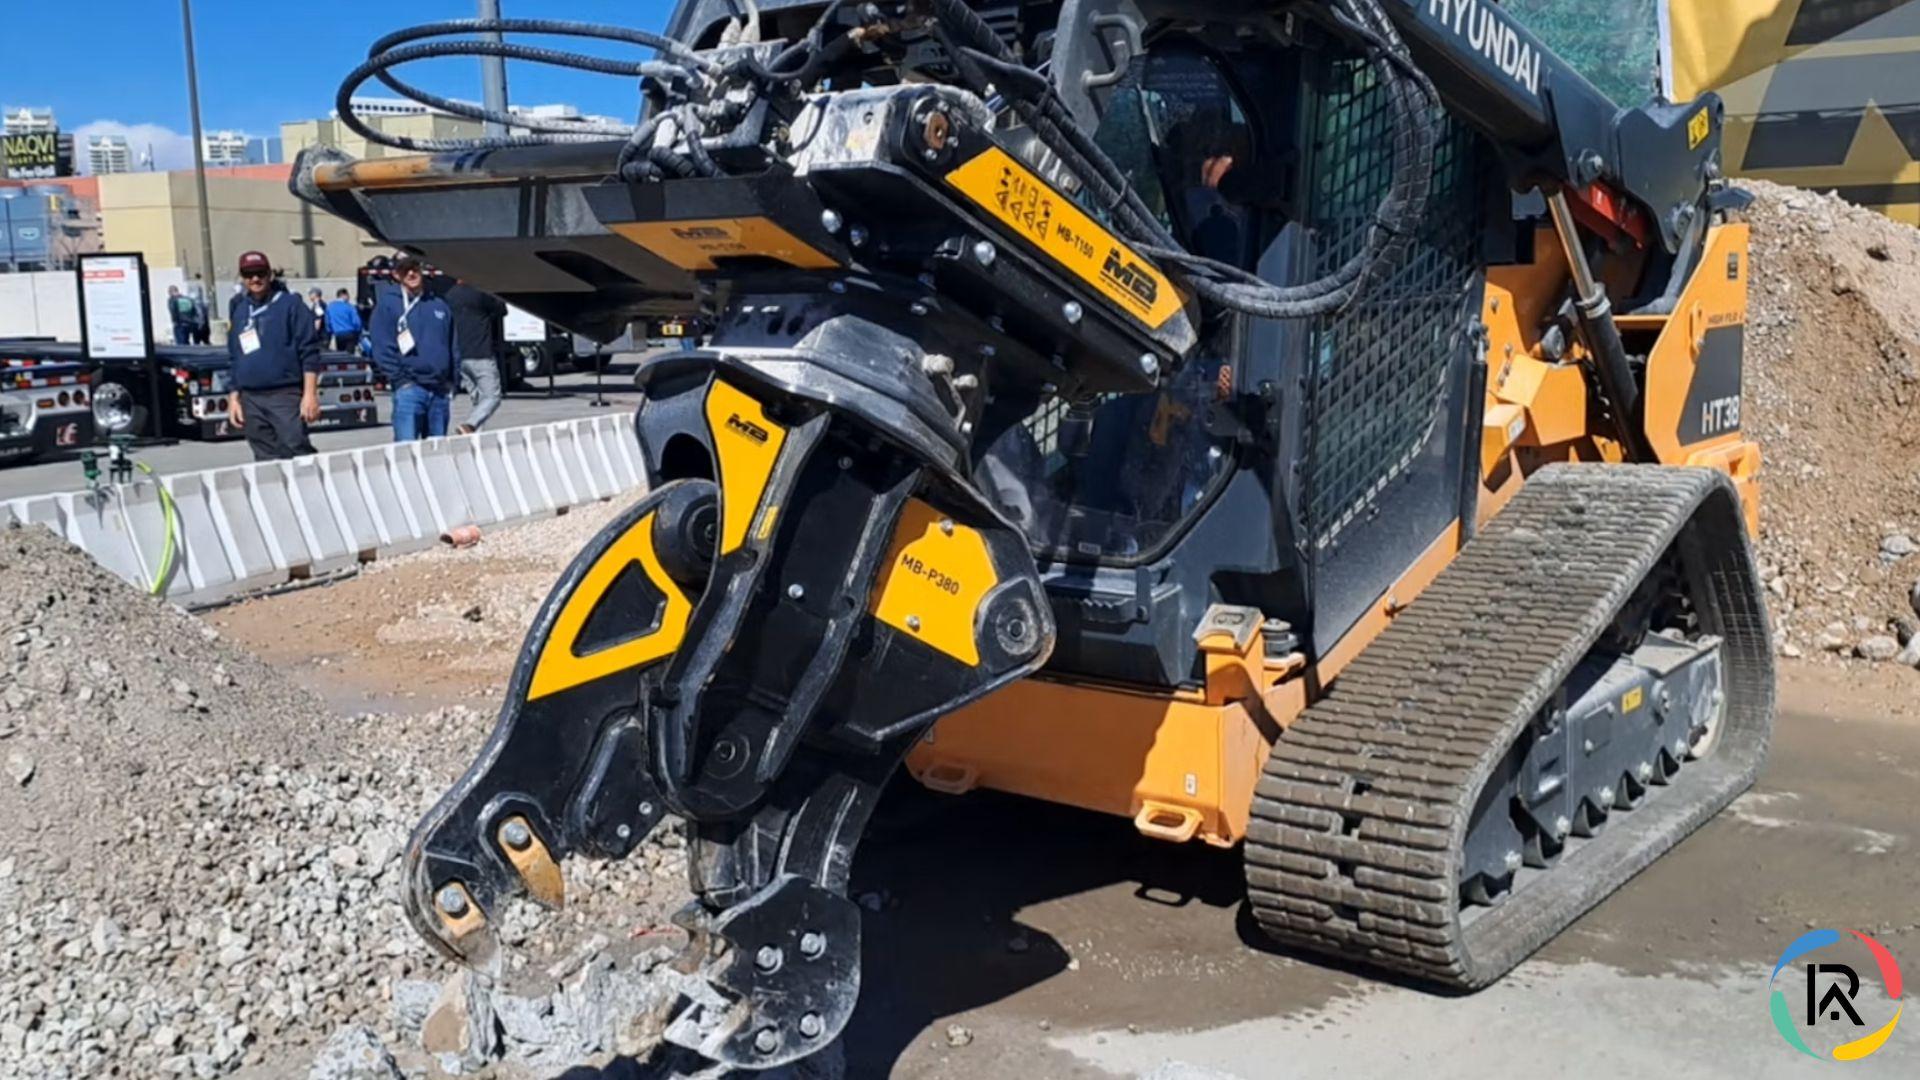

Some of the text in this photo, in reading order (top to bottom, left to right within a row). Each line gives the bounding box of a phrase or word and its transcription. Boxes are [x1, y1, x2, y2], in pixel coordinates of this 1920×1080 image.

[3, 133, 55, 156] NAQVI
[1057, 222, 1095, 259] MB-T150
[1101, 247, 1157, 304] MB
[727, 413, 768, 442] MB
[1702, 395, 1739, 434] HT38
[901, 553, 960, 595] MB-P380
